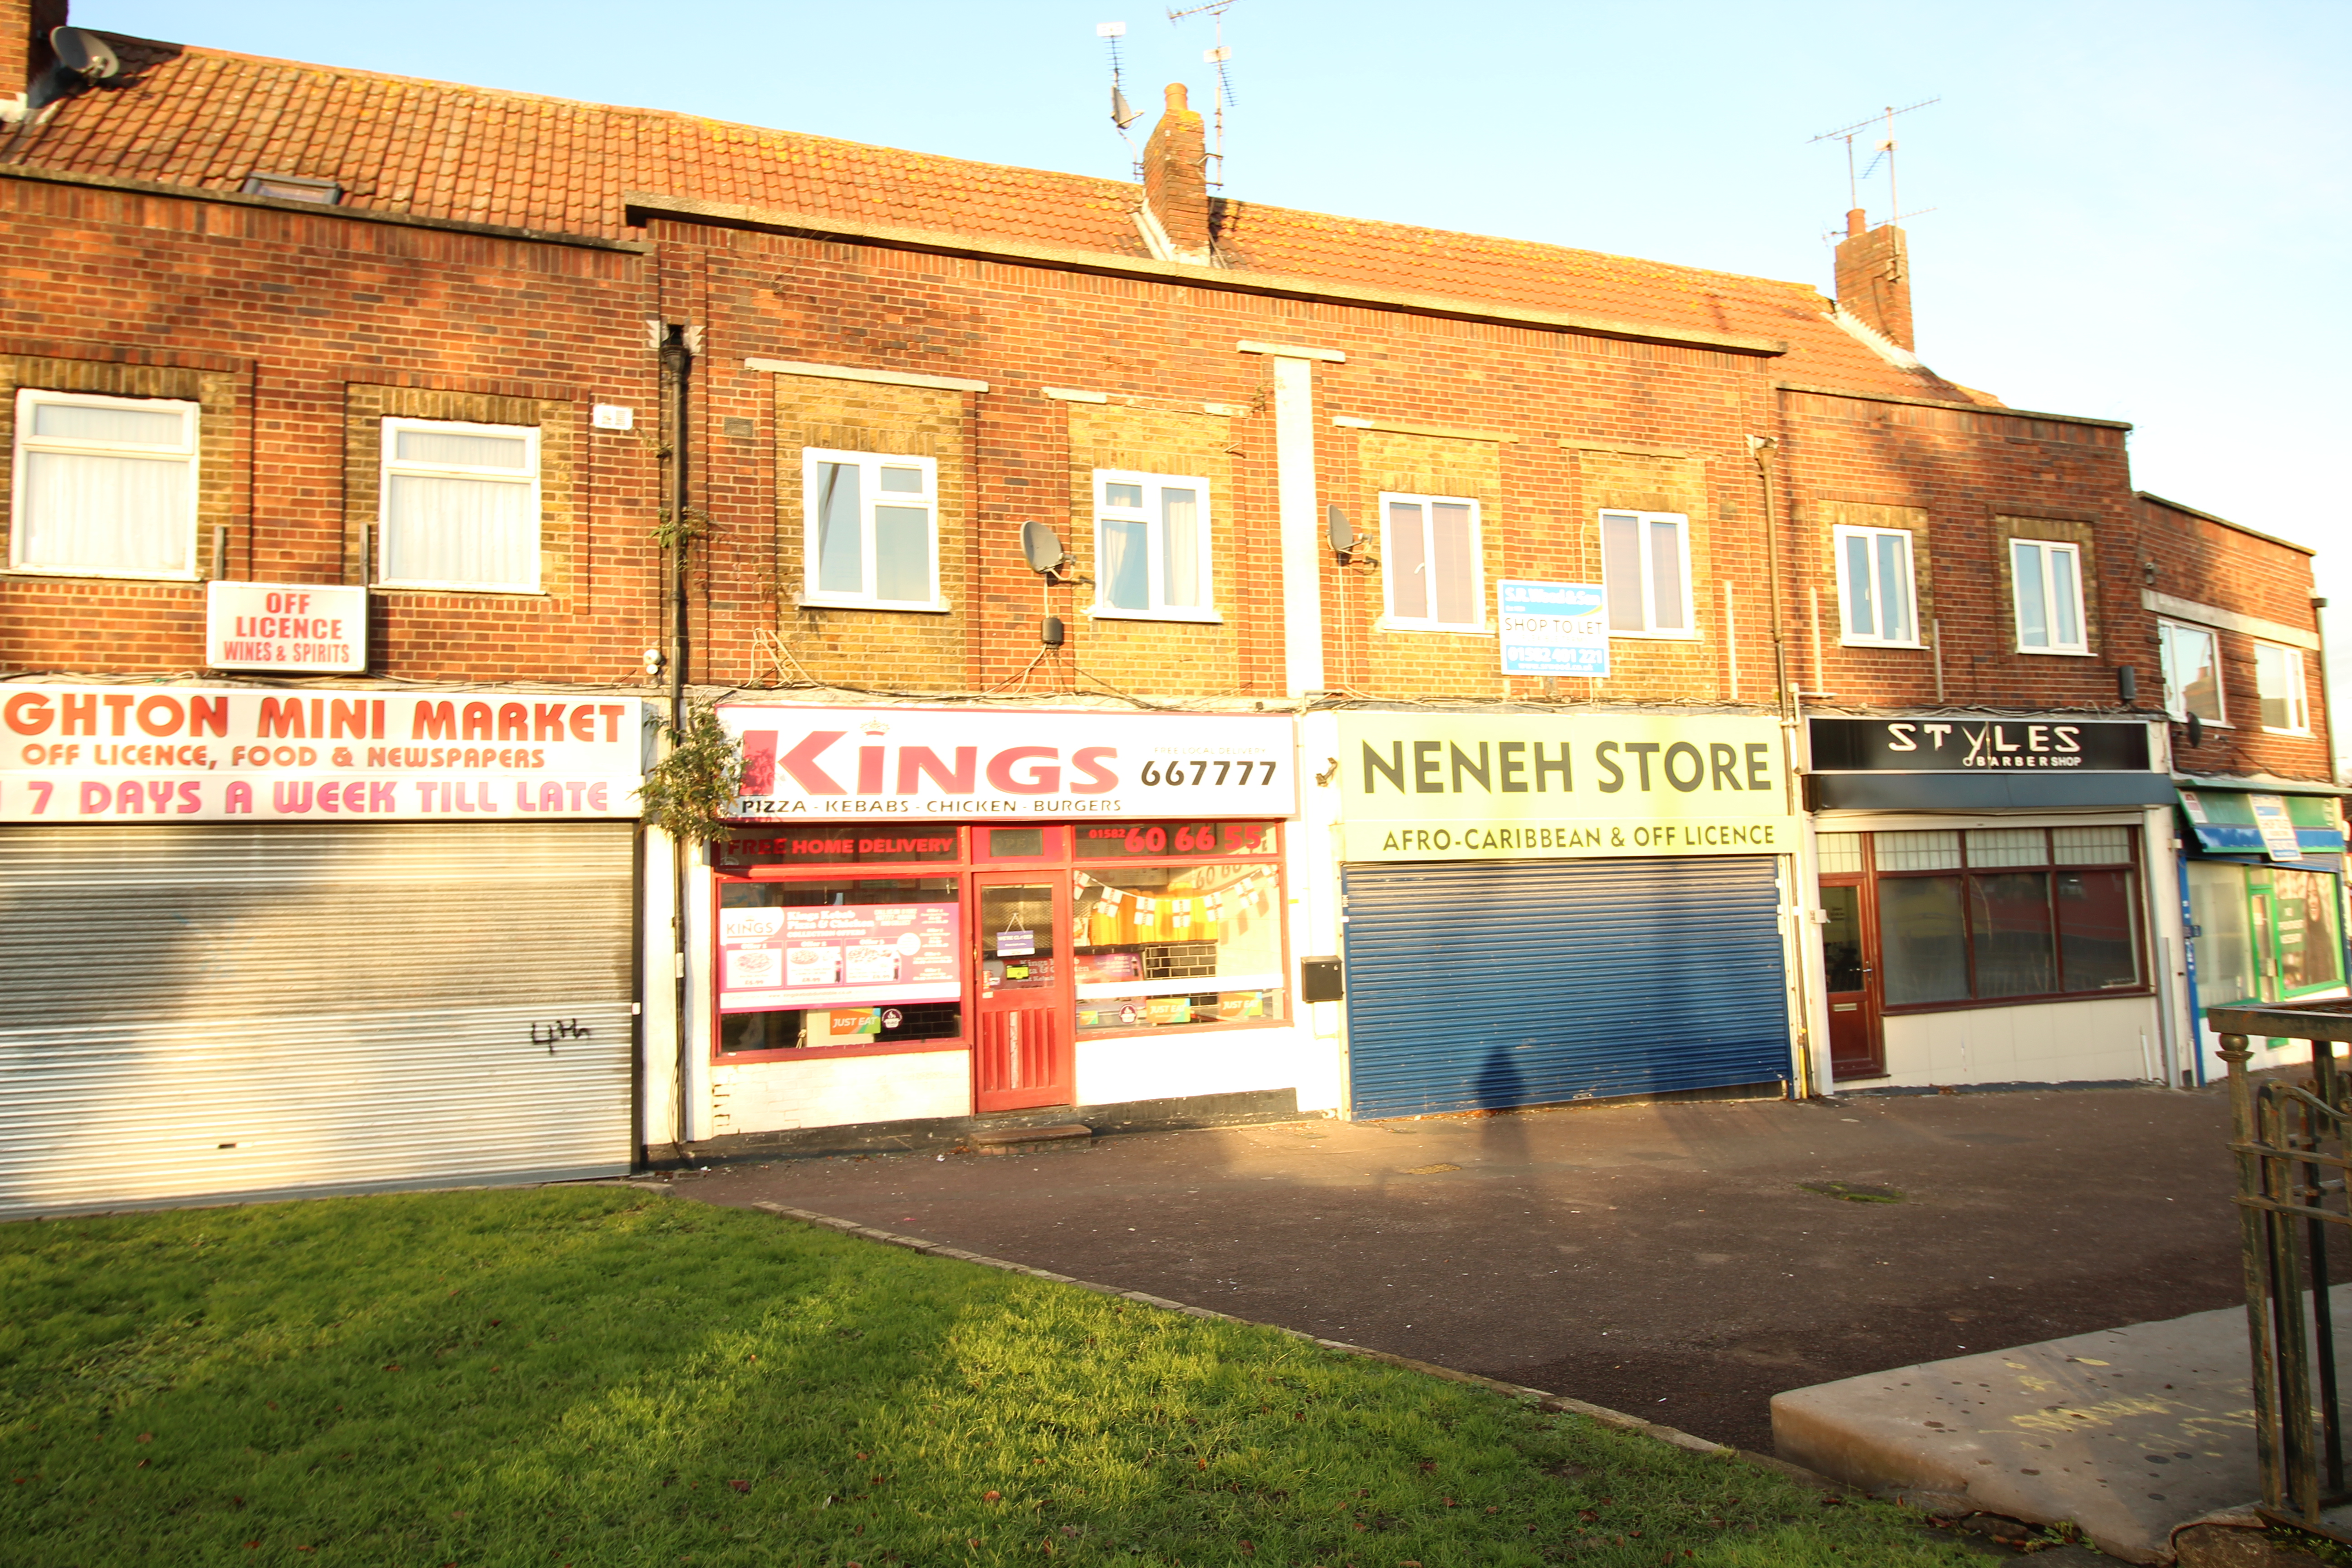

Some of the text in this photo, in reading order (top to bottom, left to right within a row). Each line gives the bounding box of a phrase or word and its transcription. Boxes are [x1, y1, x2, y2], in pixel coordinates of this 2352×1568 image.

[266, 593, 311, 614] OFF
[1528, 588, 1565, 603] Wood
[236, 616, 342, 639] LICENCE
[1505, 618, 1602, 634] SHOP TO LET
[224, 641, 349, 663] WINES & SPIRITS
[1507, 647, 1552, 662] 01582
[1578, 649, 1602, 663] 221
[4, 692, 625, 743] GHTON MINI MARKET
[1887, 723, 2080, 759] STYLES
[22, 744, 545, 770] OFF LICENCE, FOOD & NEWSPAPERS
[739, 730, 1119, 796] KINGS
[1976, 756, 2082, 767] BARBER SHOP
[1141, 761, 1276, 786] 667777
[1362, 740, 1772, 794] NENEH STORE
[29, 781, 608, 814] 7 DAYS A WEEK TILL LATE
[742, 800, 1122, 813] PIZZA KEBABS CHICKEN BURGERS
[728, 838, 954, 855] FREE HOME DELIVERY
[1089, 825, 1262, 853] 01582 60 66 55
[1383, 825, 1774, 851] AFRO-CARIBBEAN & OFF LICENCE
[787, 910, 856, 921] Kings Kebab
[787, 921, 817, 929] Pizza
[726, 922, 774, 934] KINGS
[1150, 1005, 1168, 1014] JUST
[1222, 1000, 1260, 1010] JUST EAT
[833, 1016, 877, 1028] JUST EAT
